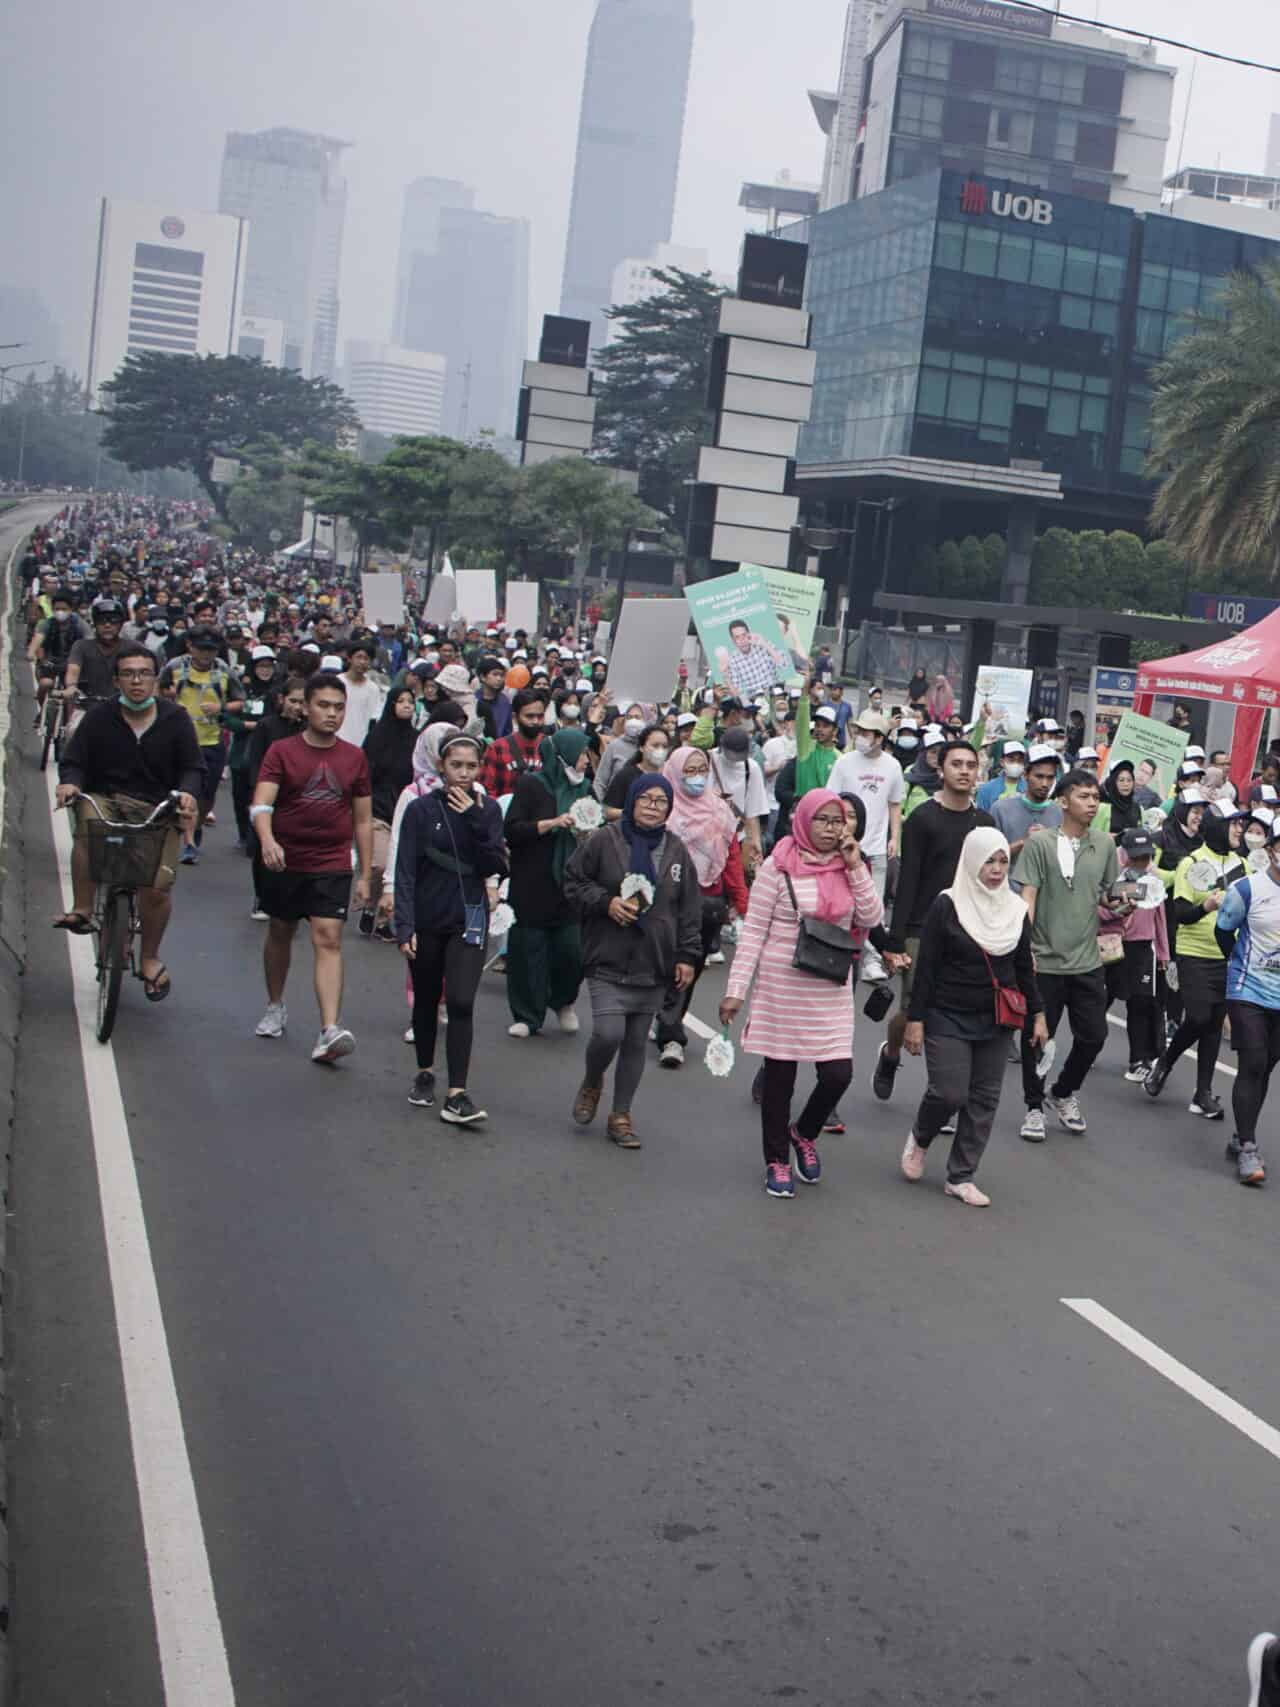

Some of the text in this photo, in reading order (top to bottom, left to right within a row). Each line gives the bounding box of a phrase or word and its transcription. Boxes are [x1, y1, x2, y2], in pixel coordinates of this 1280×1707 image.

[982, 7, 1002, 17] Inn
[991, 190, 1053, 225] UOB
[1217, 601, 1245, 624] UOB
